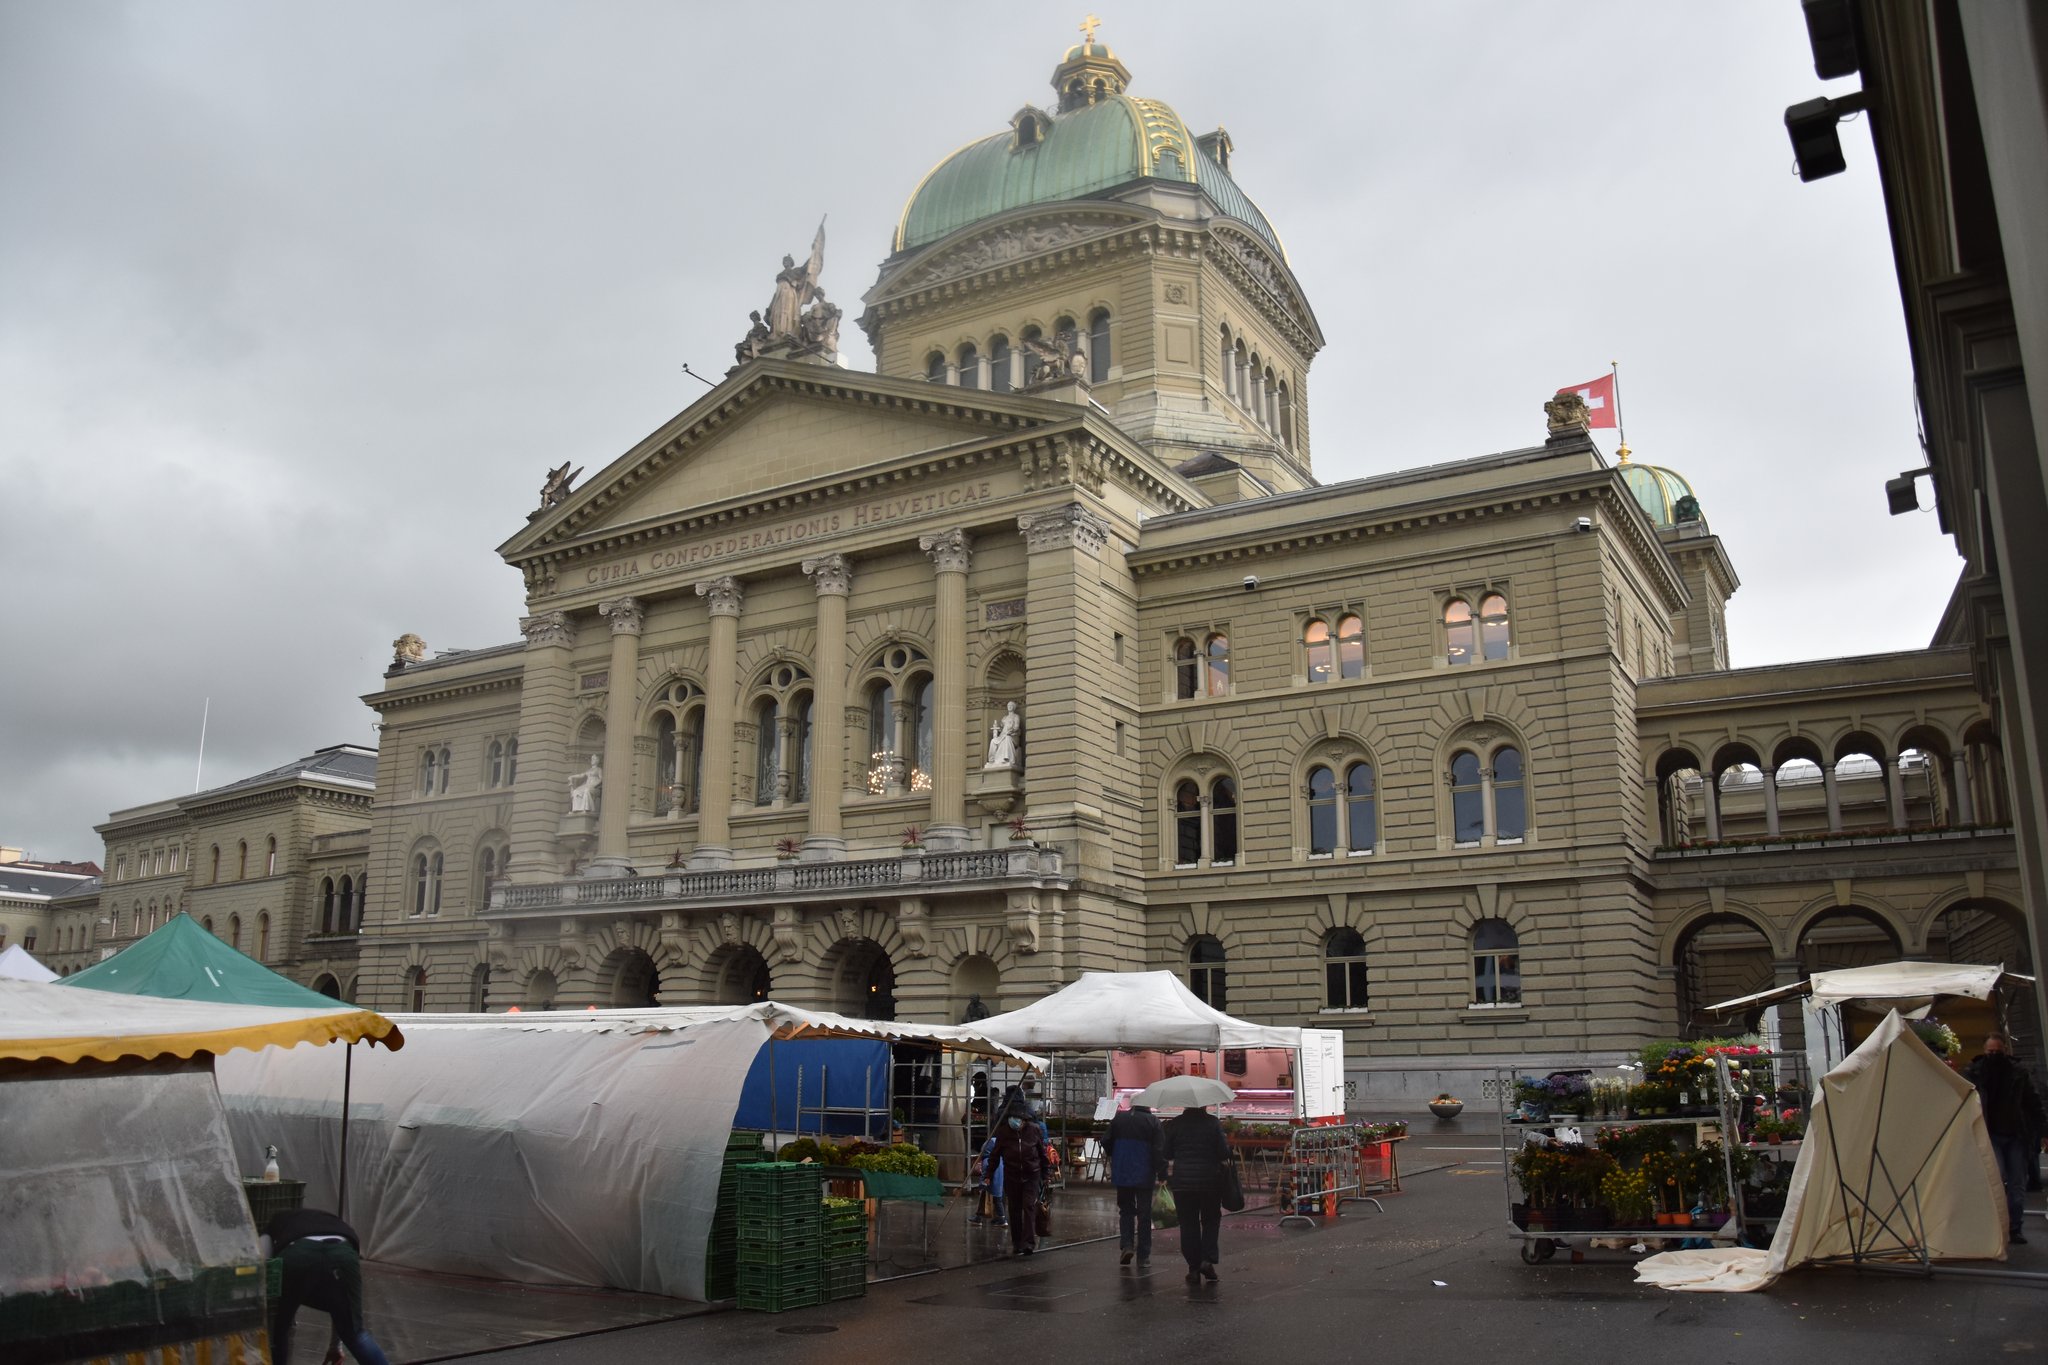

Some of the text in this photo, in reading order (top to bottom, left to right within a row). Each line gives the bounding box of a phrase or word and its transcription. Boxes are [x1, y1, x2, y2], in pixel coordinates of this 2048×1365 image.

[587, 482, 991, 584] CURIA CONFOEDERATIONIS HELVETICAE
